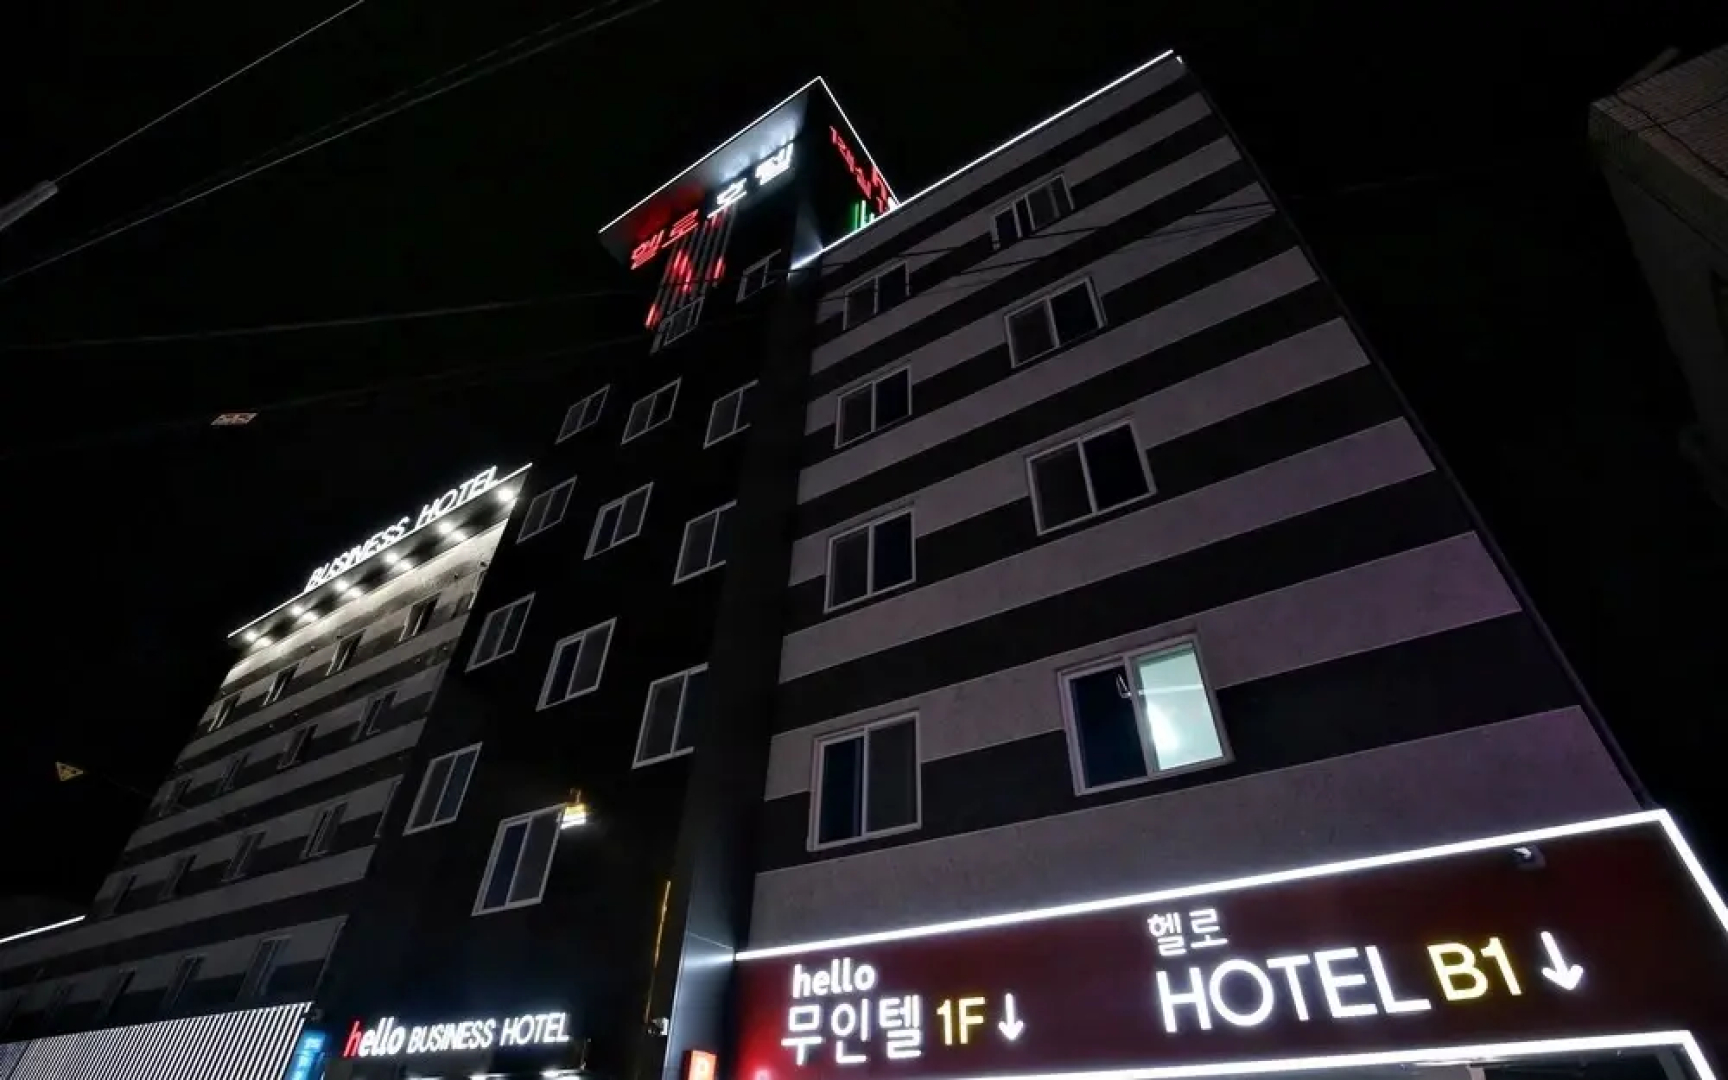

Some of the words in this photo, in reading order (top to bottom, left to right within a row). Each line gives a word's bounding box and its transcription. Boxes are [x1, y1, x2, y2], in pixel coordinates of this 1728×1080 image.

[414, 465, 500, 529] HOTEL
[1146, 908, 1229, 957] 헬로
[791, 957, 878, 998] hello
[1155, 944, 1432, 1033] HOTEL
[1426, 936, 1522, 1001] B1
[343, 1015, 405, 1058] hello
[407, 1018, 497, 1054] BUSINESS
[499, 1012, 570, 1047] HOTEL
[780, 998, 922, 1066] 무인텔
[935, 996, 987, 1046] 1F
